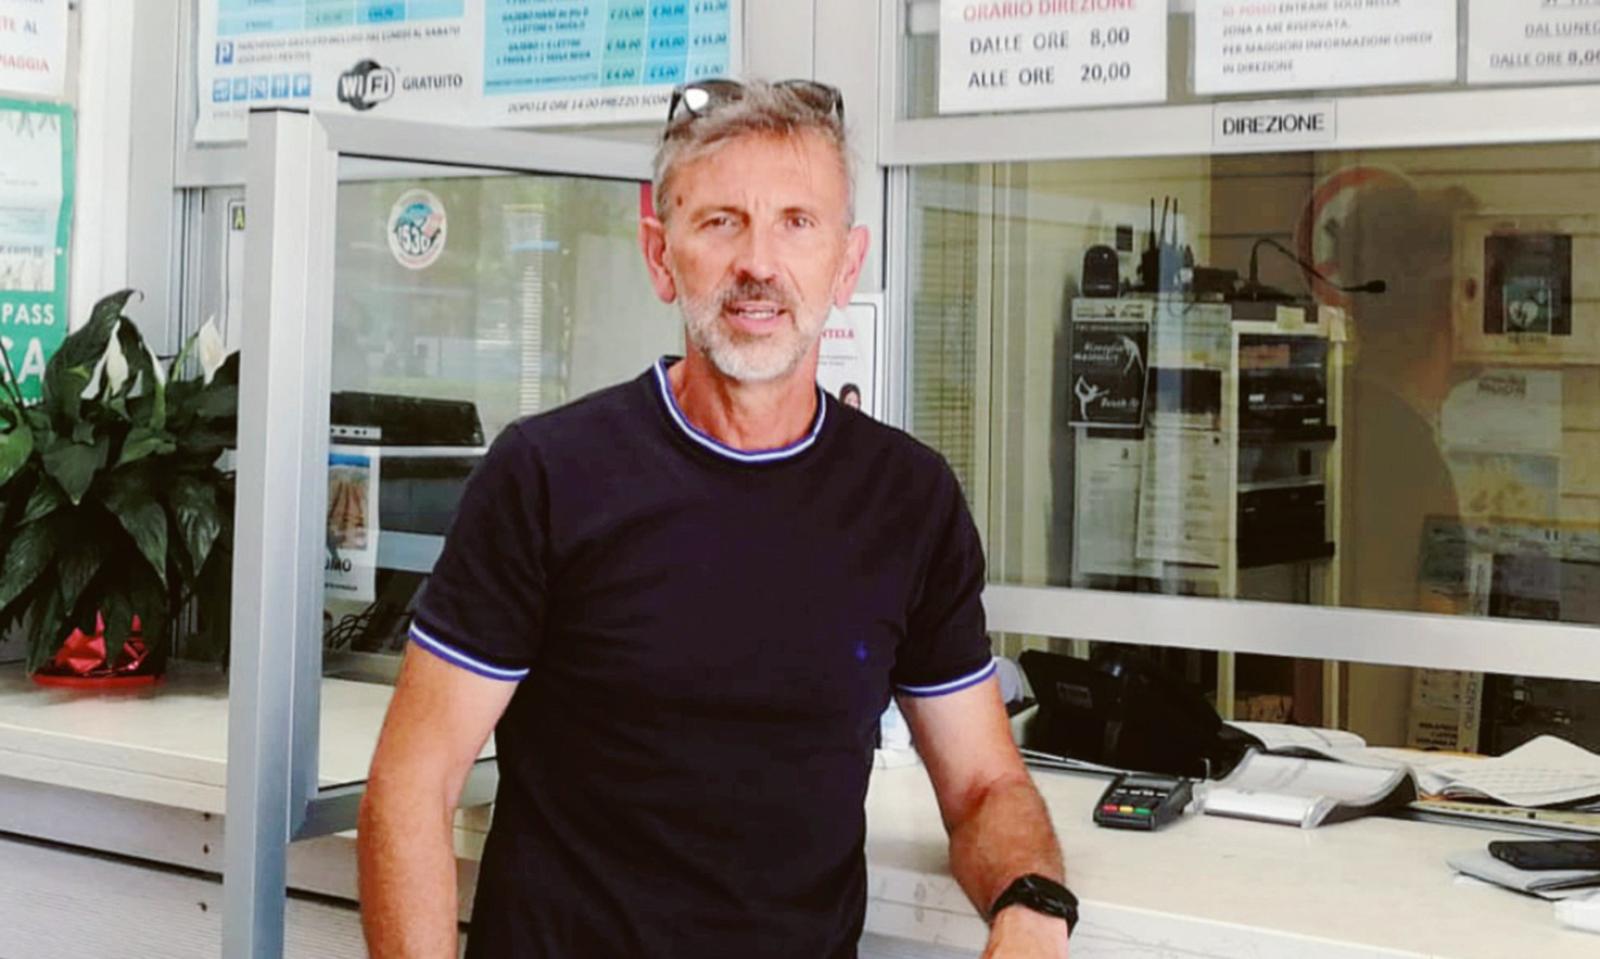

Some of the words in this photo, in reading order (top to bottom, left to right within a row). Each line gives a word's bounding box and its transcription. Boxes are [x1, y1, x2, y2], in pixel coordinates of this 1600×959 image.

[963, 1, 1033, 23] ORARIO
[1038, 0, 1136, 19] DIREZIONE
[22, 18, 39, 36] AL
[969, 33, 1022, 55] DALLE
[1032, 30, 1069, 51] ORE
[1089, 27, 1130, 48] 8,00
[401, 73, 463, 92] GRATUITO
[968, 69, 1009, 90] ALLE
[1018, 67, 1055, 86] ORE
[1080, 62, 1131, 84] 20,00
[1221, 112, 1326, 137] DIREZIONE
[2, 302, 55, 326] PASS
